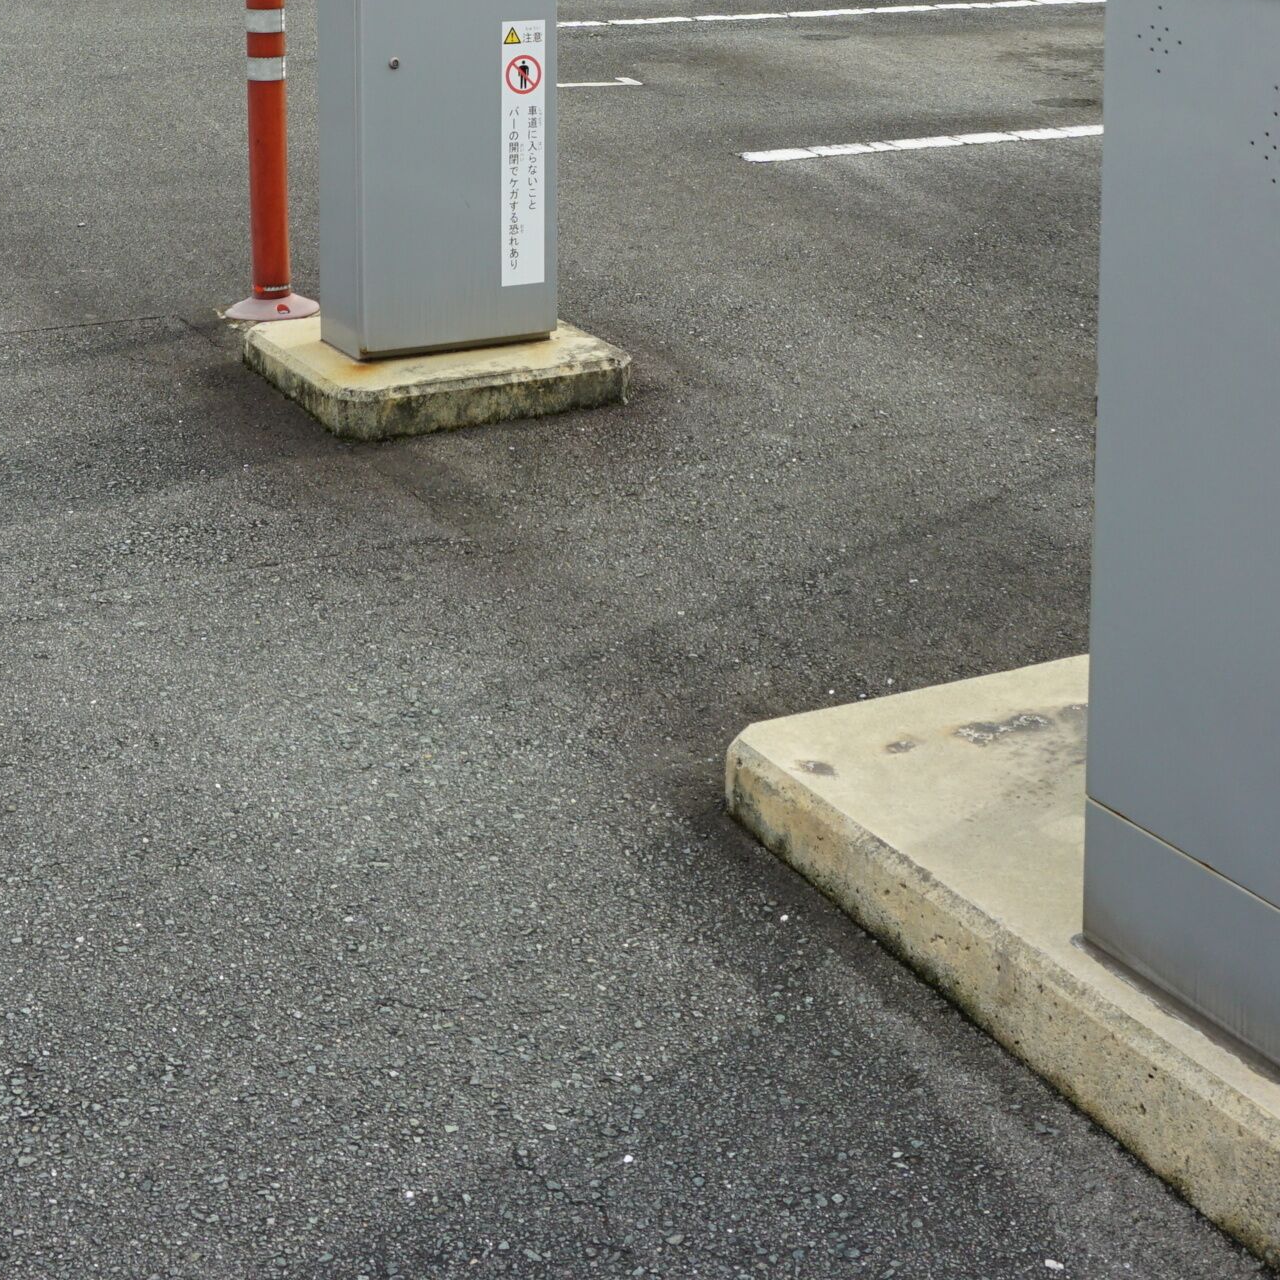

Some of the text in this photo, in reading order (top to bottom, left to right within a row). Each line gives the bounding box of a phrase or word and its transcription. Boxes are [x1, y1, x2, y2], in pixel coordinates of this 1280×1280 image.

[523, 32, 542, 43] 注意
[509, 106, 519, 270] バーの開閉でケガする恐れあり
[527, 105, 538, 210] 車道に入らないこと
